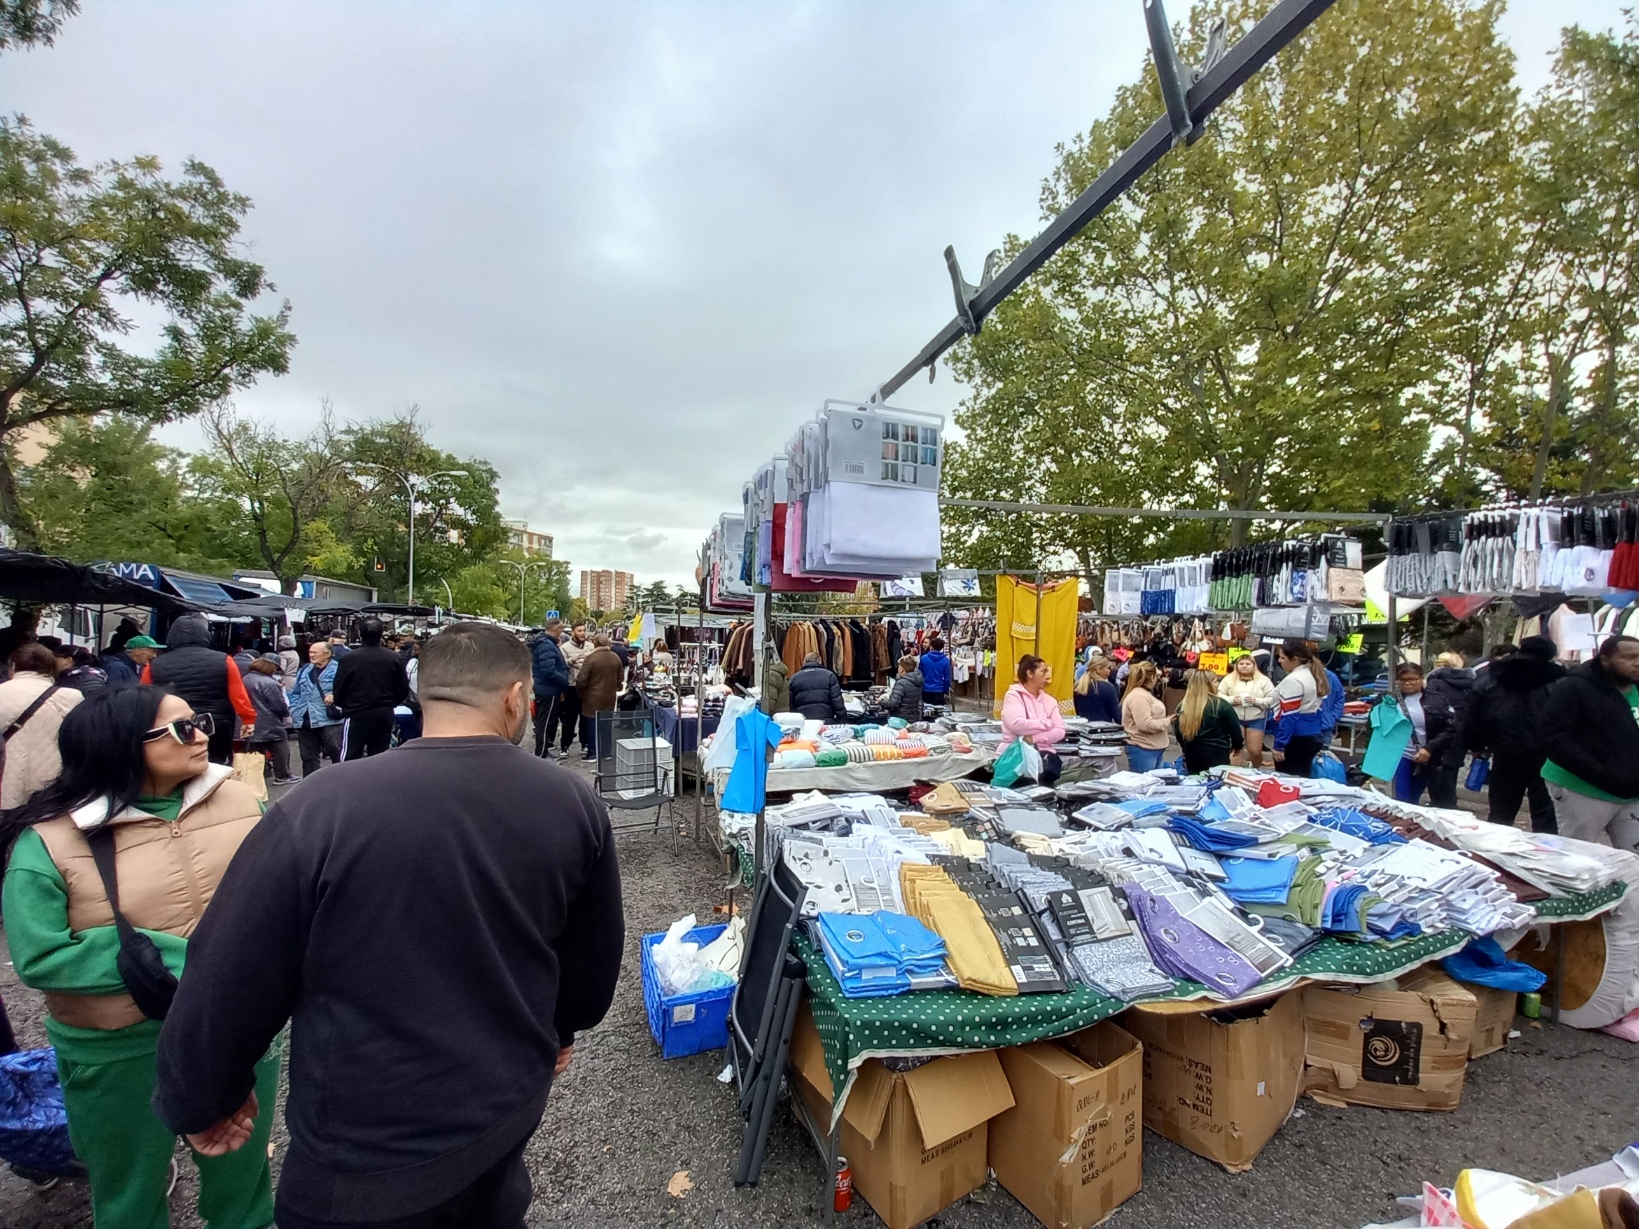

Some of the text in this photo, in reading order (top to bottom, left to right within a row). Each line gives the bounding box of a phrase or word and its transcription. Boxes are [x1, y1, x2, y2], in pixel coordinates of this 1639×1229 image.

[1193, 1091, 1213, 1107] QTY:
[1192, 1103, 1213, 1117] ITEM
[1081, 1136, 1096, 1151] QTY:
[1081, 1148, 1096, 1162] N.W:
[1081, 1160, 1096, 1174] G.W:
[1081, 1168, 1101, 1187] MEAS:
